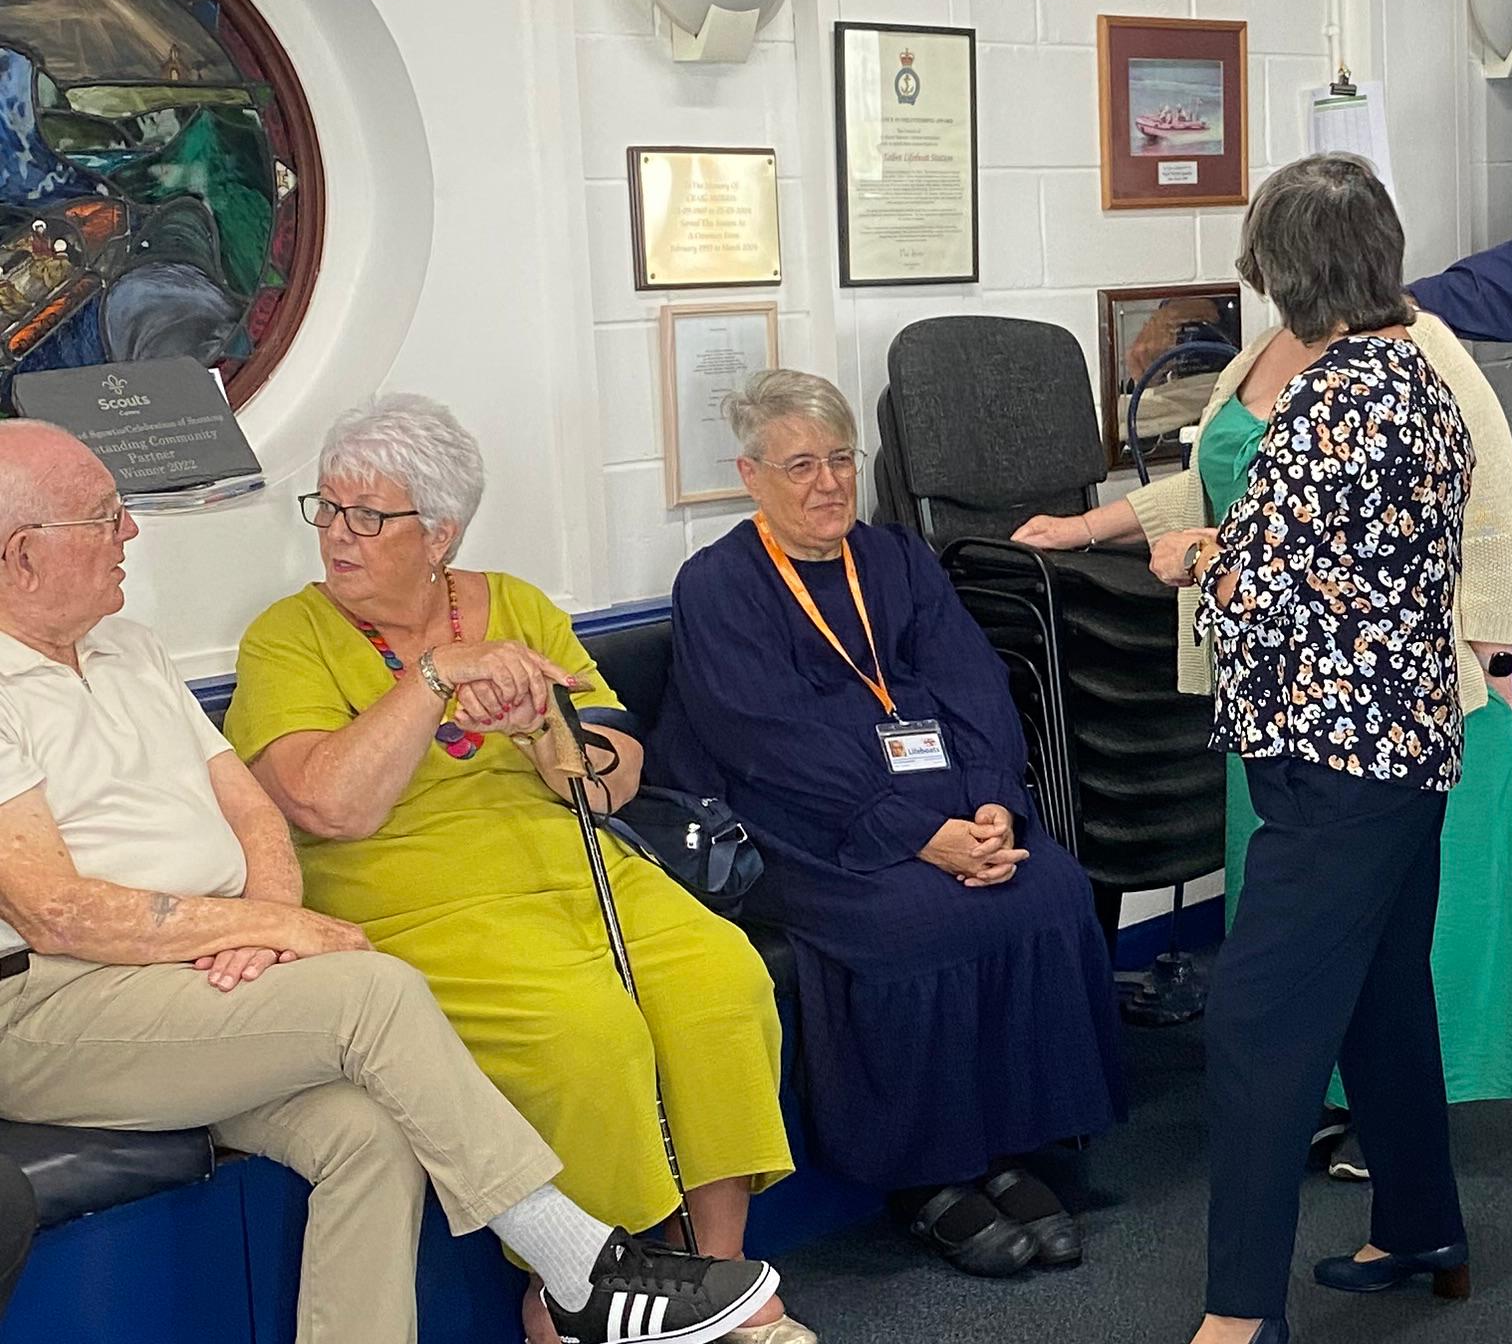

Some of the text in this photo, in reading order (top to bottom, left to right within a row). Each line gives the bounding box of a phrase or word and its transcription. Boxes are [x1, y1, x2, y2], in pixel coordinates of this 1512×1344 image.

[98, 394, 151, 411] Scouts
[147, 428, 219, 449] Community
[126, 449, 176, 465] Partner
[118, 459, 199, 481] Winner 2022
